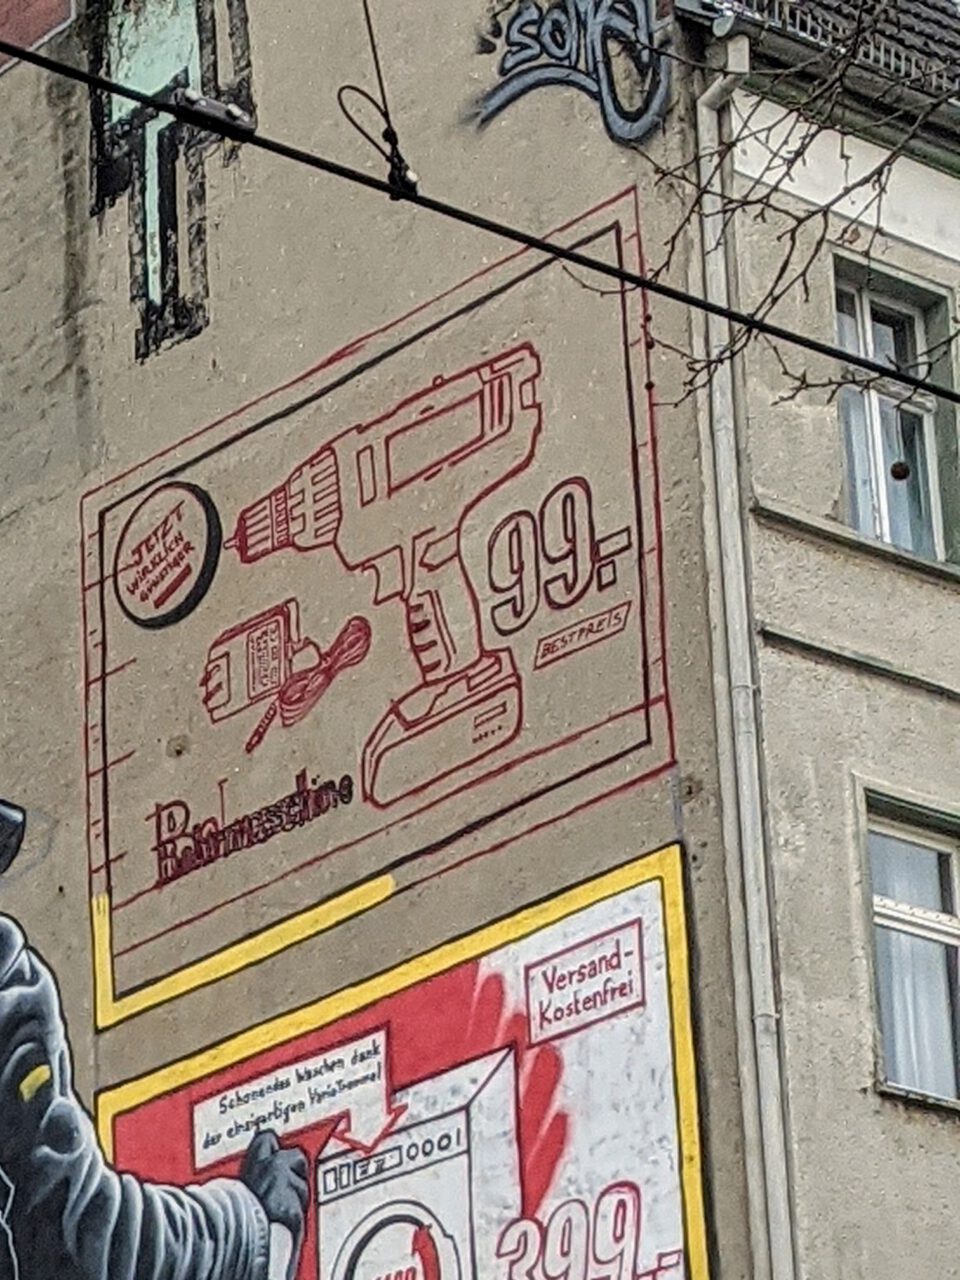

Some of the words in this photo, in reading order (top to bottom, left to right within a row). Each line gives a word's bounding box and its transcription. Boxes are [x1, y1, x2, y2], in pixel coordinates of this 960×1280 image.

[131, 500, 185, 566] JETZT
[541, 611, 623, 659] BESTPREIS
[542, 938, 634, 994] Versand-
[539, 970, 634, 1030] Kostenfrei
[219, 1076, 291, 1114] Schonendes
[351, 1040, 381, 1065] dank
